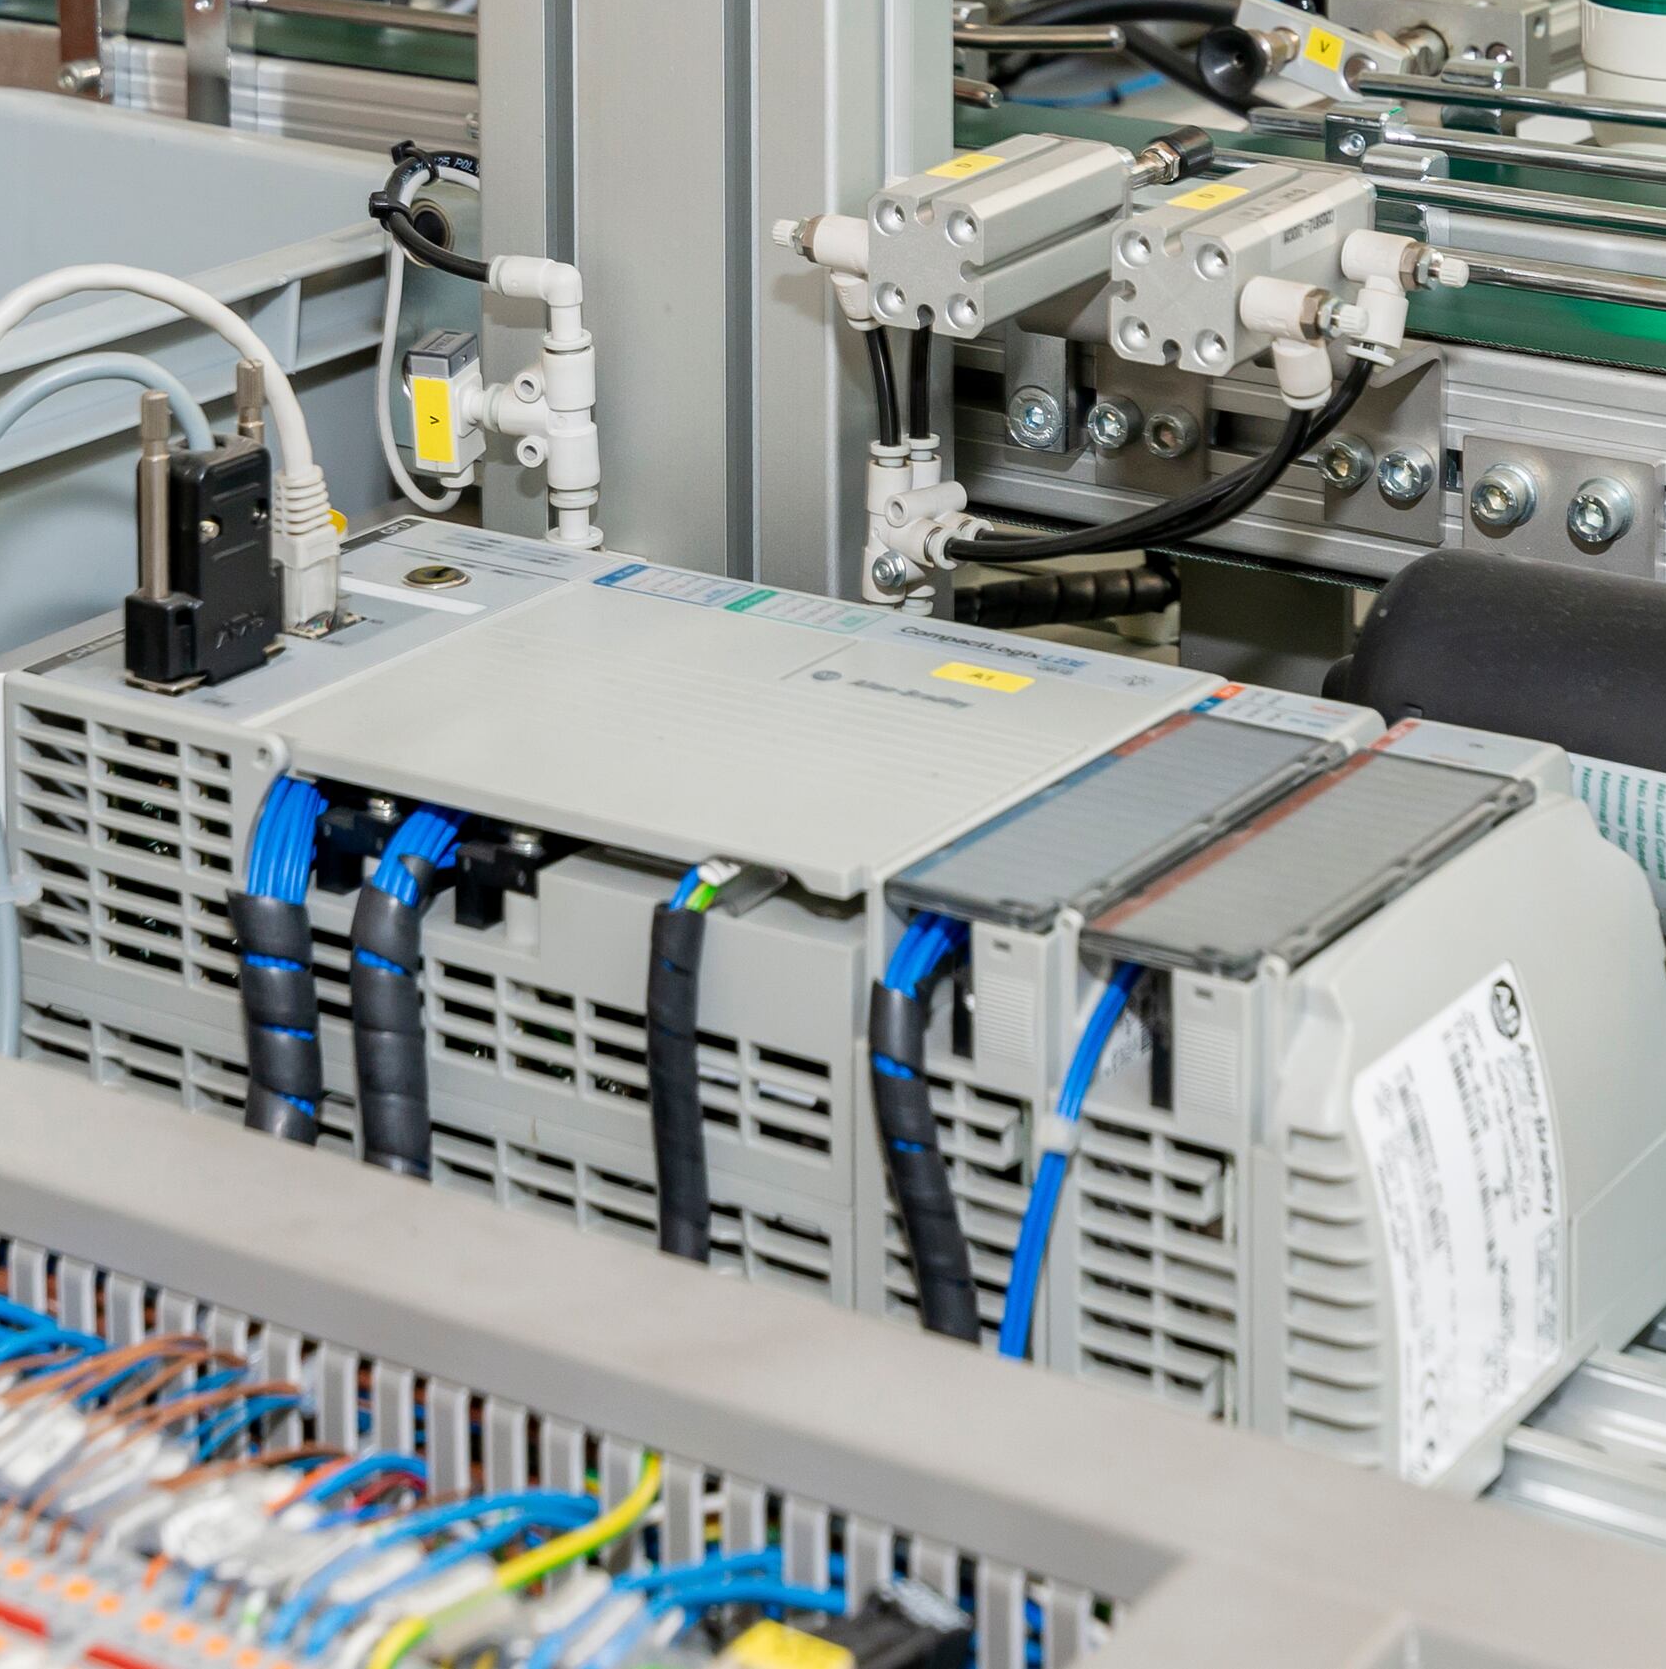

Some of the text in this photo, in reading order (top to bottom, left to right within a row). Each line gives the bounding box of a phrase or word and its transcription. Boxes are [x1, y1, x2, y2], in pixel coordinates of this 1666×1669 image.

[1320, 40, 1330, 52] V
[901, 626, 1038, 660] CompactLogix
[970, 672, 997, 682] A1
[1599, 770, 1611, 824] Nominal
[1618, 774, 1630, 826] Nominal
[1637, 779, 1648, 798] No
[1636, 801, 1647, 832] Load
[1655, 806, 1666, 836] Load
